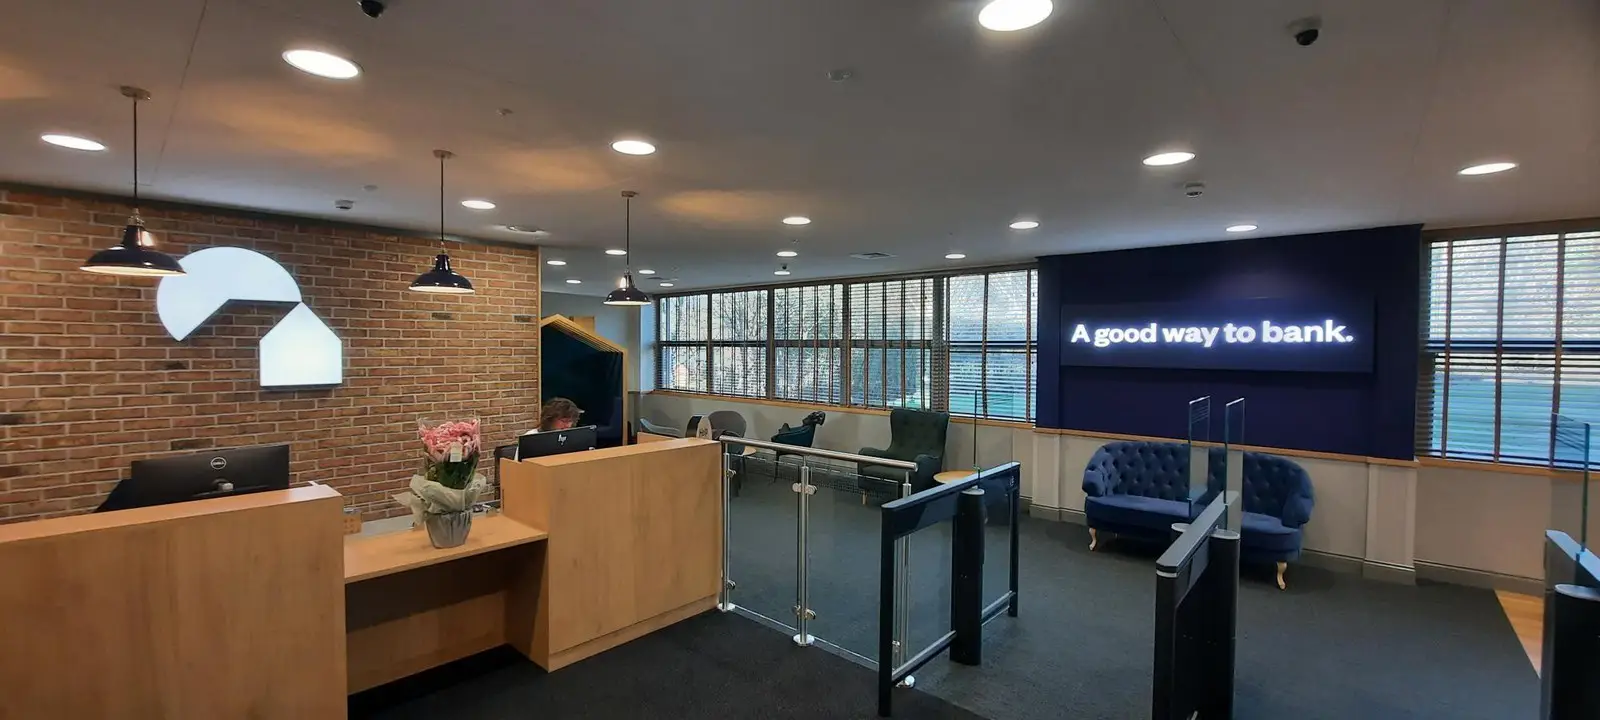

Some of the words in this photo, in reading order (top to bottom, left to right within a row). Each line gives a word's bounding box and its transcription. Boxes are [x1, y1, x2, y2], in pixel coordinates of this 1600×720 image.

[1070, 323, 1091, 343] A
[1094, 322, 1157, 347] good
[1162, 326, 1219, 348] way
[1223, 322, 1256, 343] to
[1262, 319, 1354, 343] bank.
